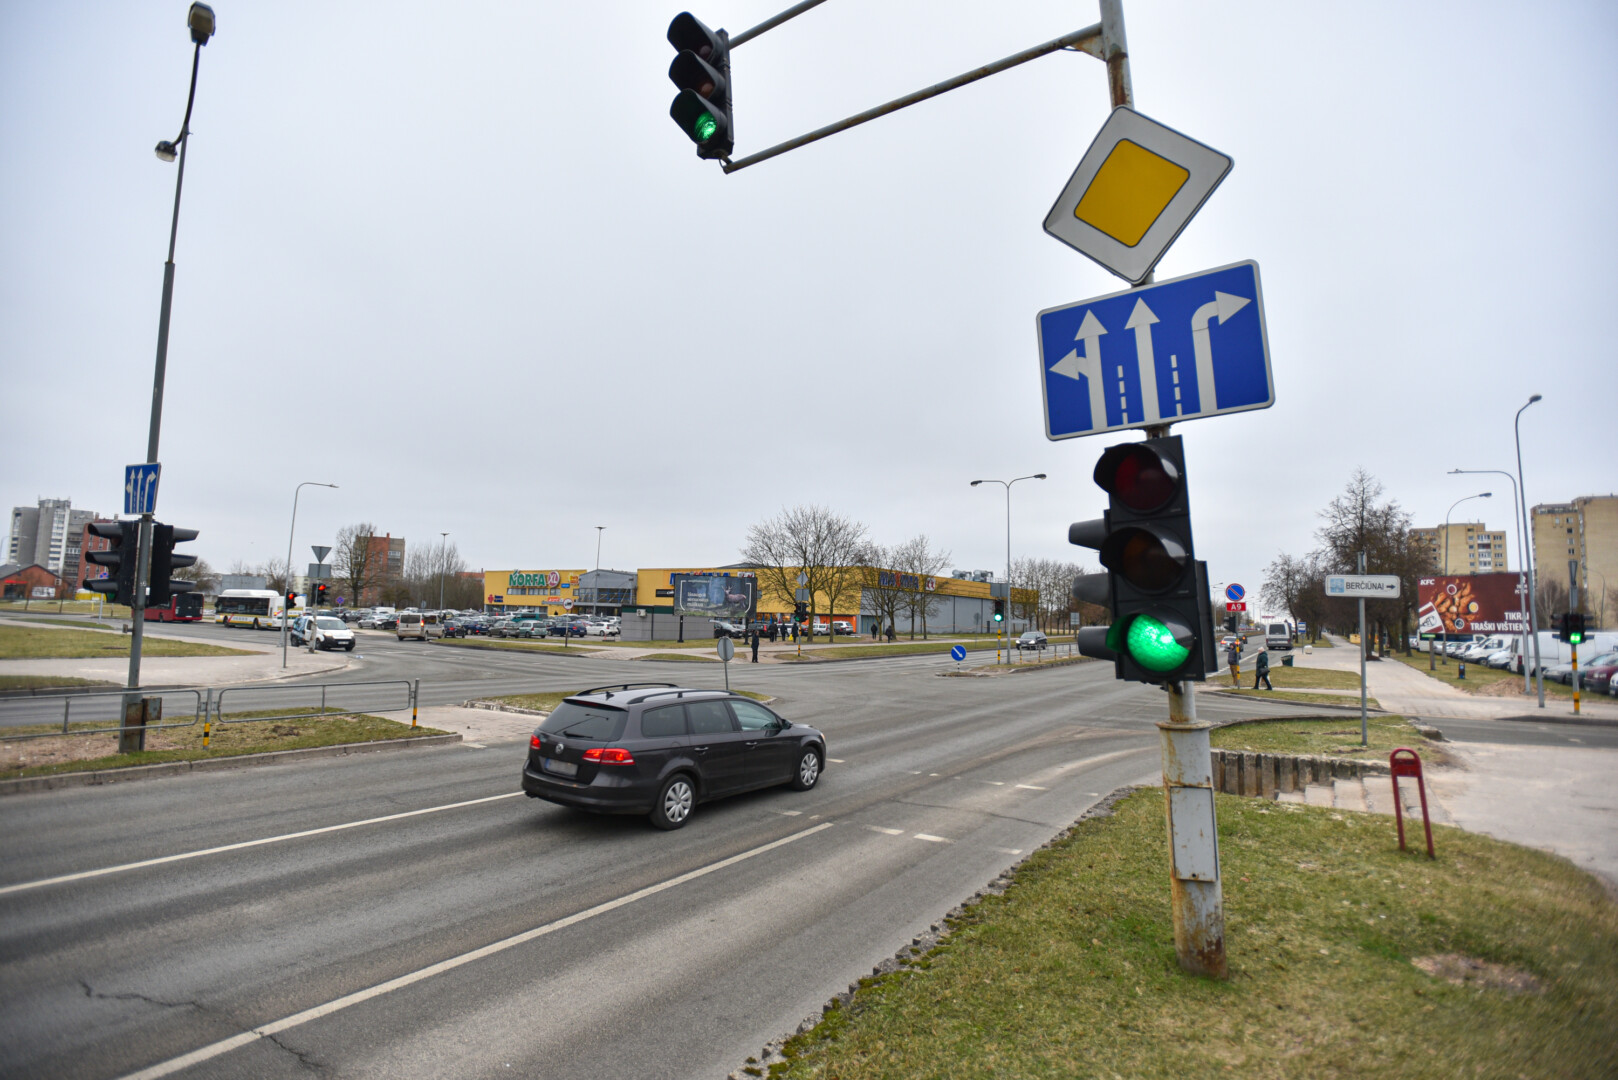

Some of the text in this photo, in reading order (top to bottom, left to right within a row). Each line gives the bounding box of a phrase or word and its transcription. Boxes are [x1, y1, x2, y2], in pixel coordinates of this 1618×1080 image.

[508, 571, 546, 587] NORFA
[548, 572, 559, 586] XL
[1345, 580, 1385, 590] BERČIŪNAI
[1504, 612, 1530, 620] TIKRI
[1470, 621, 1496, 631] TRAŠKI
